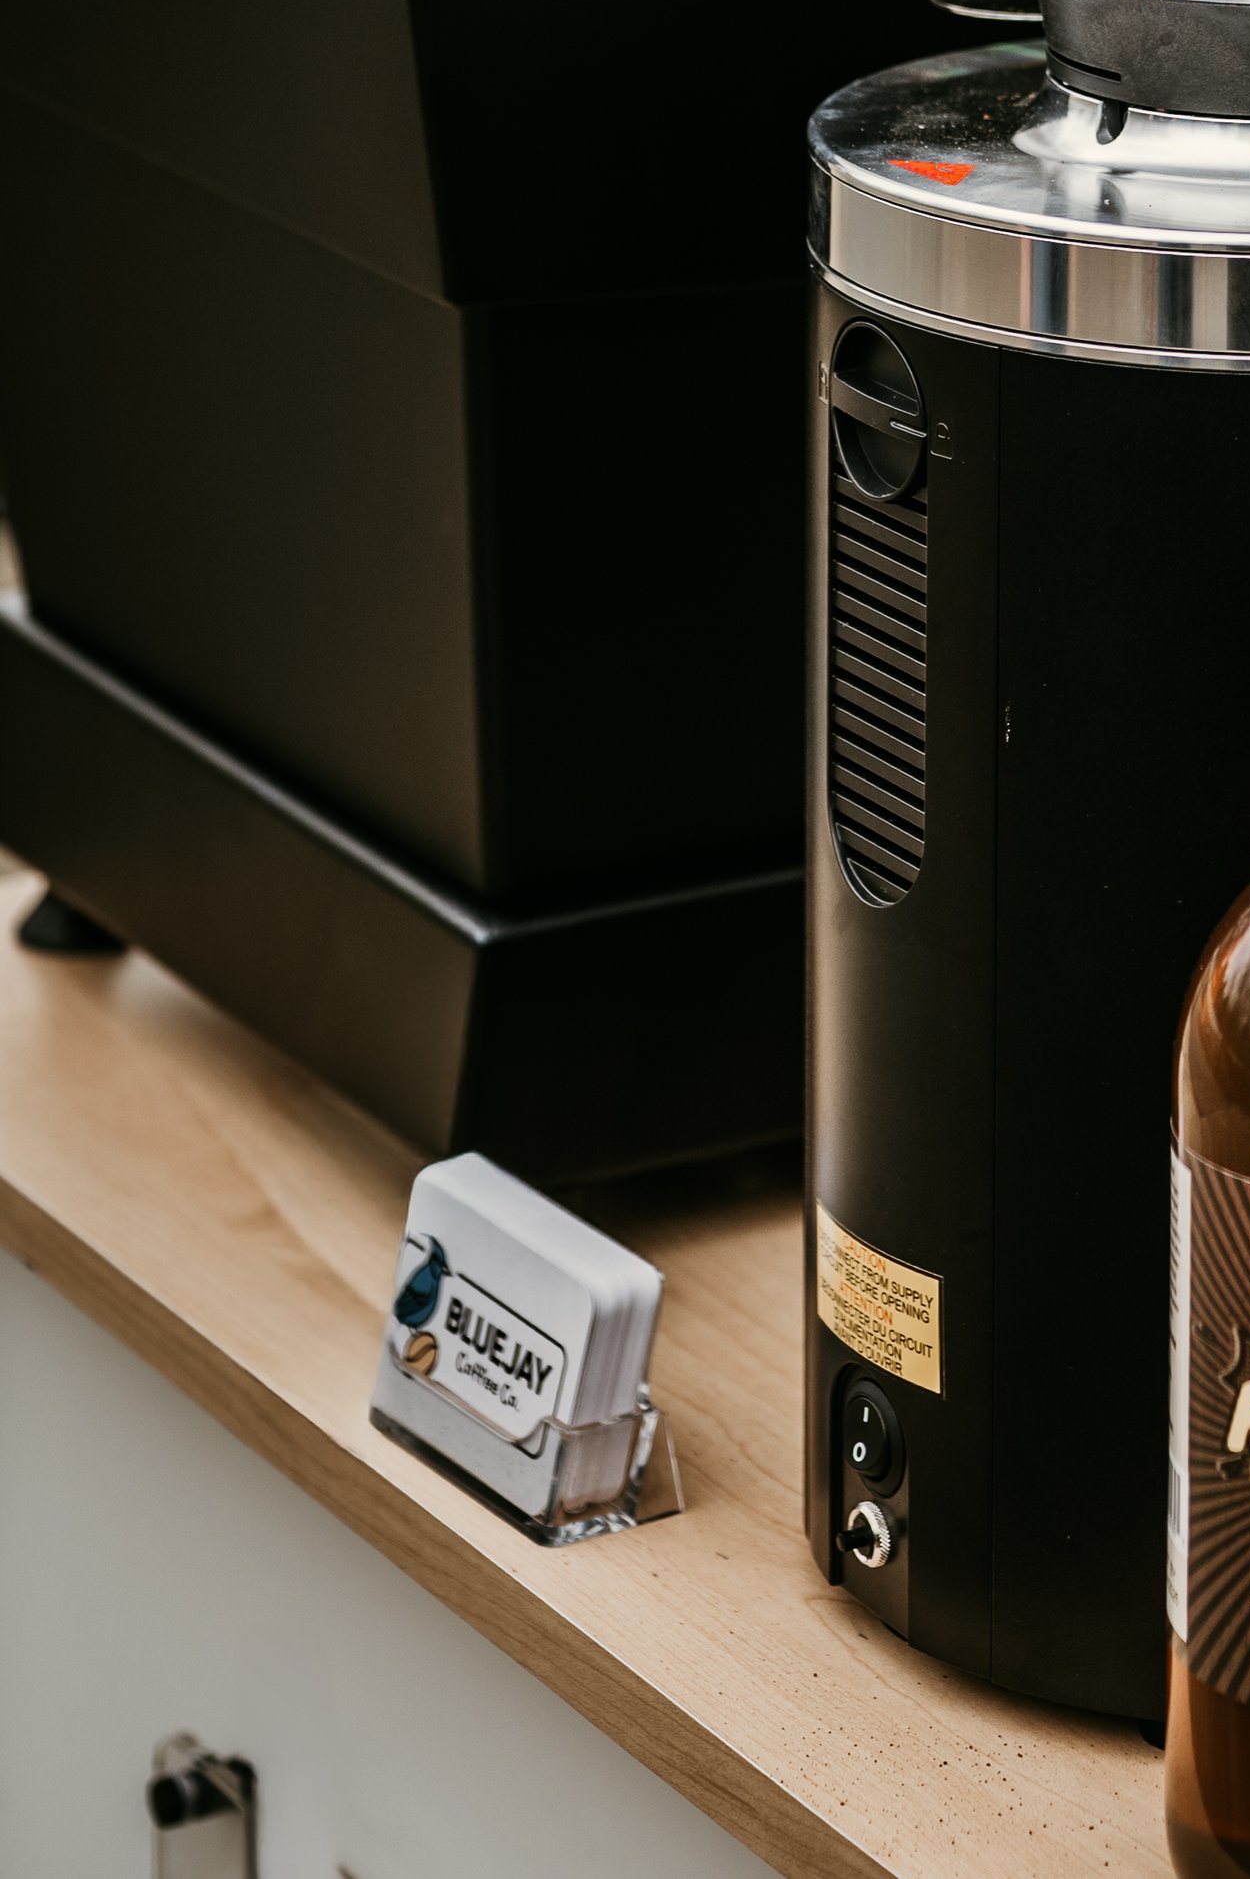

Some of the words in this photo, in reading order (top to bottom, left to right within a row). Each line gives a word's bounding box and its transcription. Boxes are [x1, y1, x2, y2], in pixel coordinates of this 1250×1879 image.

[842, 1234, 887, 1274] CAUTION
[839, 1282, 893, 1327] ATTENTION
[845, 1267, 879, 1301] BEFORE
[880, 1292, 930, 1325] OPENING
[861, 1264, 889, 1290] FROM
[890, 1281, 934, 1309] SUPPLY
[444, 1295, 553, 1396] BLUEJAY
[872, 1319, 887, 1339] DU
[888, 1329, 934, 1359] CIRCUIT
[455, 1350, 499, 1396] Coffee
